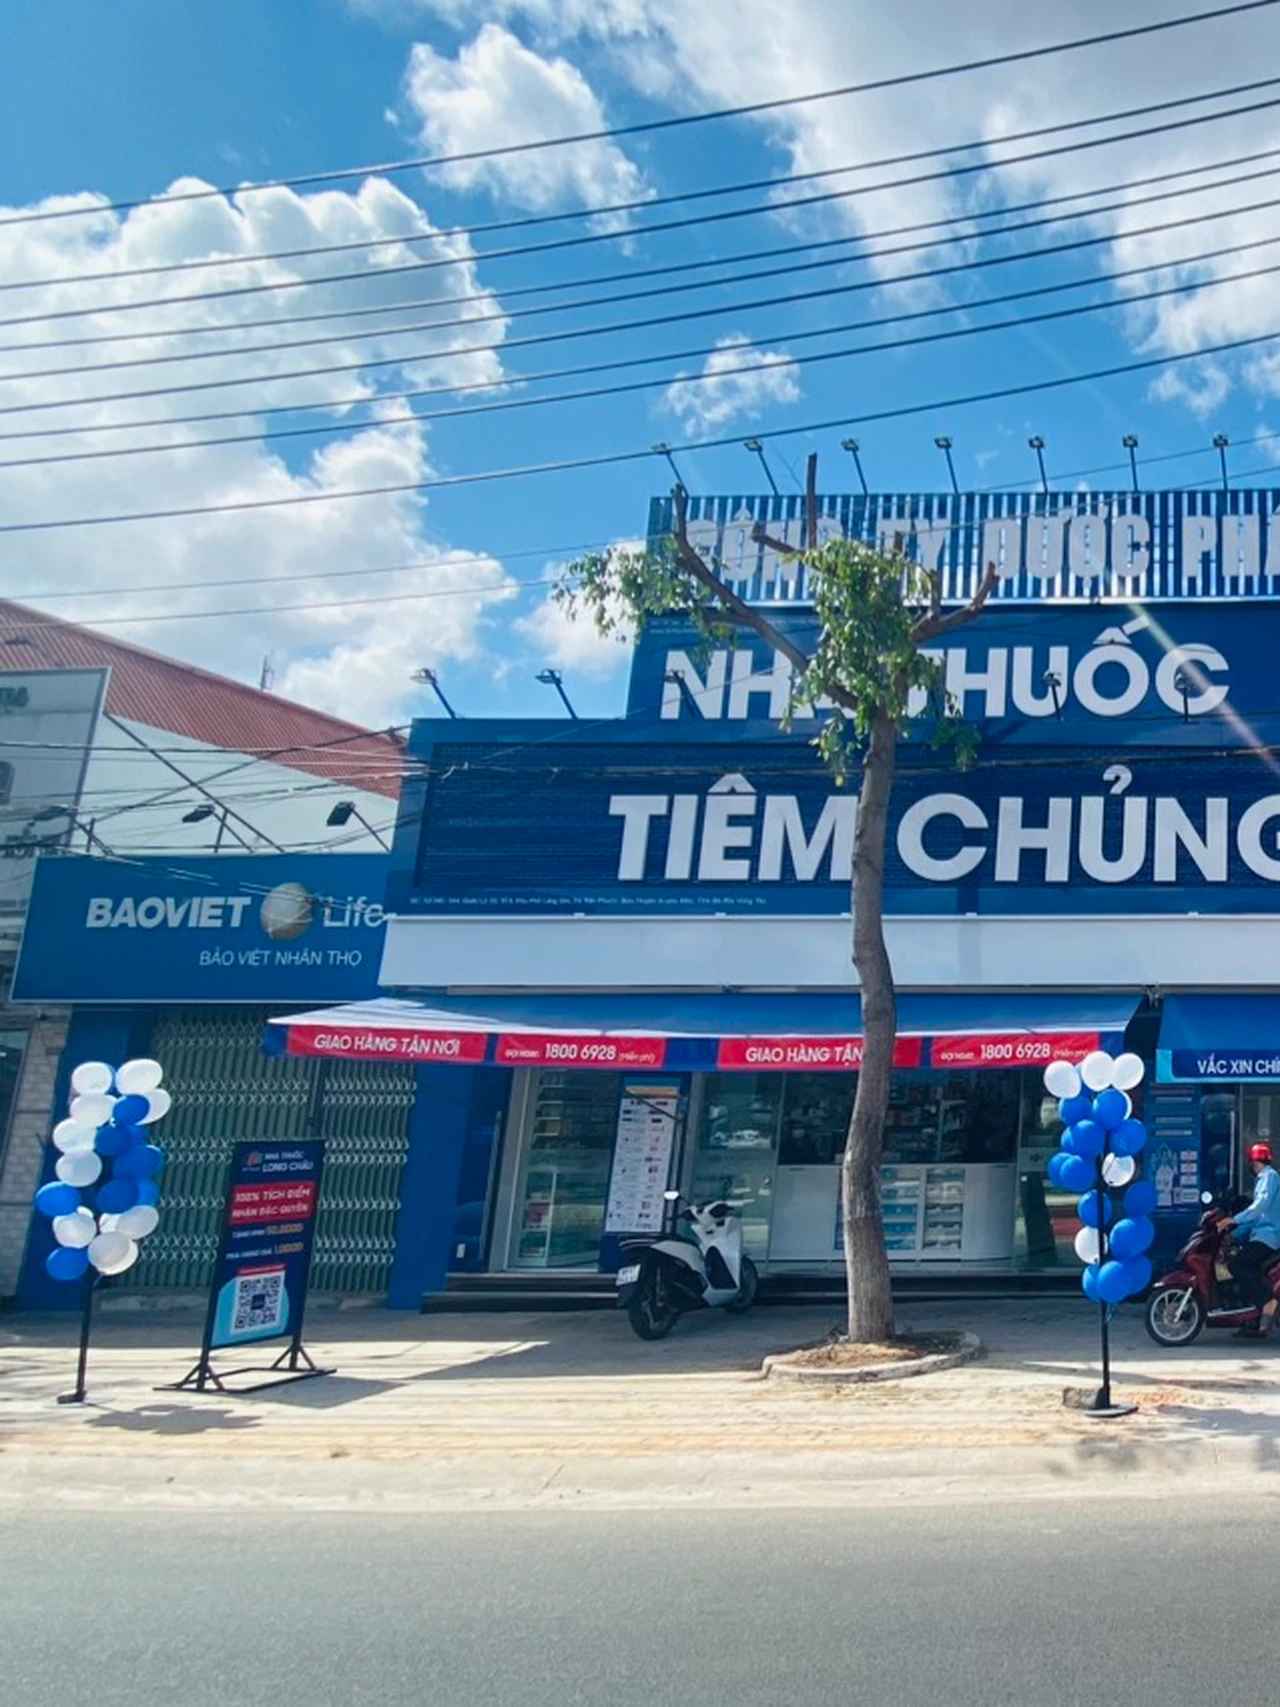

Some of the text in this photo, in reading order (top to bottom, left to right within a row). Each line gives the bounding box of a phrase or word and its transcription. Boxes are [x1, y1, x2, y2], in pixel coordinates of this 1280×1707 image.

[983, 504, 1151, 588] DƯỢC
[659, 648, 858, 720] NH
[608, 773, 856, 882] TIÊM
[86, 896, 252, 929] BAOVIET
[314, 1031, 461, 1057] GIAO HÀNG TẬN NƠI
[545, 1043, 578, 1059] 1800
[580, 1043, 617, 1060] 6928
[745, 1042, 864, 1067] GIAO HÀNG TẬN
[980, 1043, 1013, 1060] 1800
[1015, 1042, 1051, 1059] 6928
[1197, 1053, 1228, 1074] VẮC
[1229, 1060, 1253, 1074] XIN
